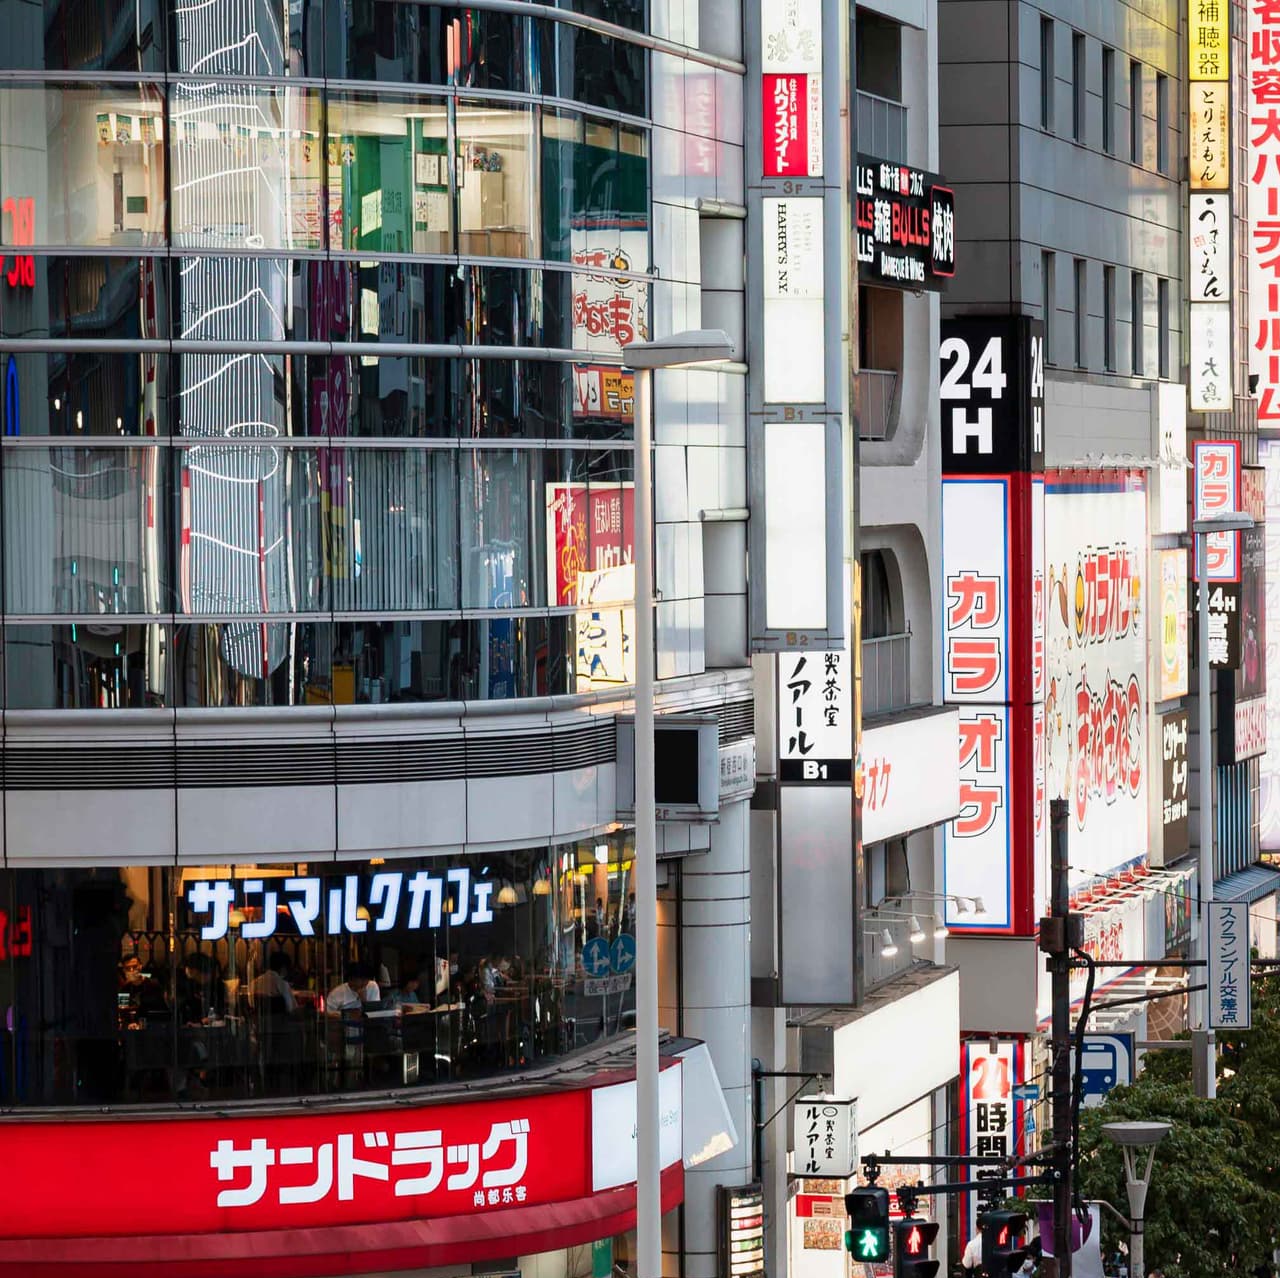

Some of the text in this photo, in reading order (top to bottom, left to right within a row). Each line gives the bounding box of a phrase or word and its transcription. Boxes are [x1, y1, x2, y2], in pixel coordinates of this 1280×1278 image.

[1197, 0, 1221, 75] 補聴器
[773, 78, 789, 173] ハウスメイト
[1200, 90, 1217, 181] とりえもん
[782, 181, 803, 195] 3F
[777, 203, 788, 266] HARRY'S
[874, 199, 929, 248] 新宿 BULLS
[932, 201, 954, 263] 焼肉
[939, 336, 1008, 400] 24
[1030, 335, 1044, 398] 24
[951, 407, 993, 454] H
[1033, 409, 1042, 454] H
[1083, 542, 1131, 648] カラオケ
[786, 632, 809, 646] B2
[1207, 612, 1229, 664] 営業
[786, 656, 815, 756] ノアール
[822, 652, 842, 727] 喫茶室
[945, 570, 1003, 839] カラオケ
[803, 761, 828, 780] B1
[1074, 662, 1142, 833] まねきねこ
[188, 864, 495, 941] サンマルクカフェ
[1218, 906, 1239, 1024] スクランブル交差点
[972, 1056, 1011, 1099] 24
[210, 1118, 531, 1209] サンドラッグ
[805, 1105, 821, 1174] ルノアール
[472, 1184, 528, 1208] 尚都乐客
